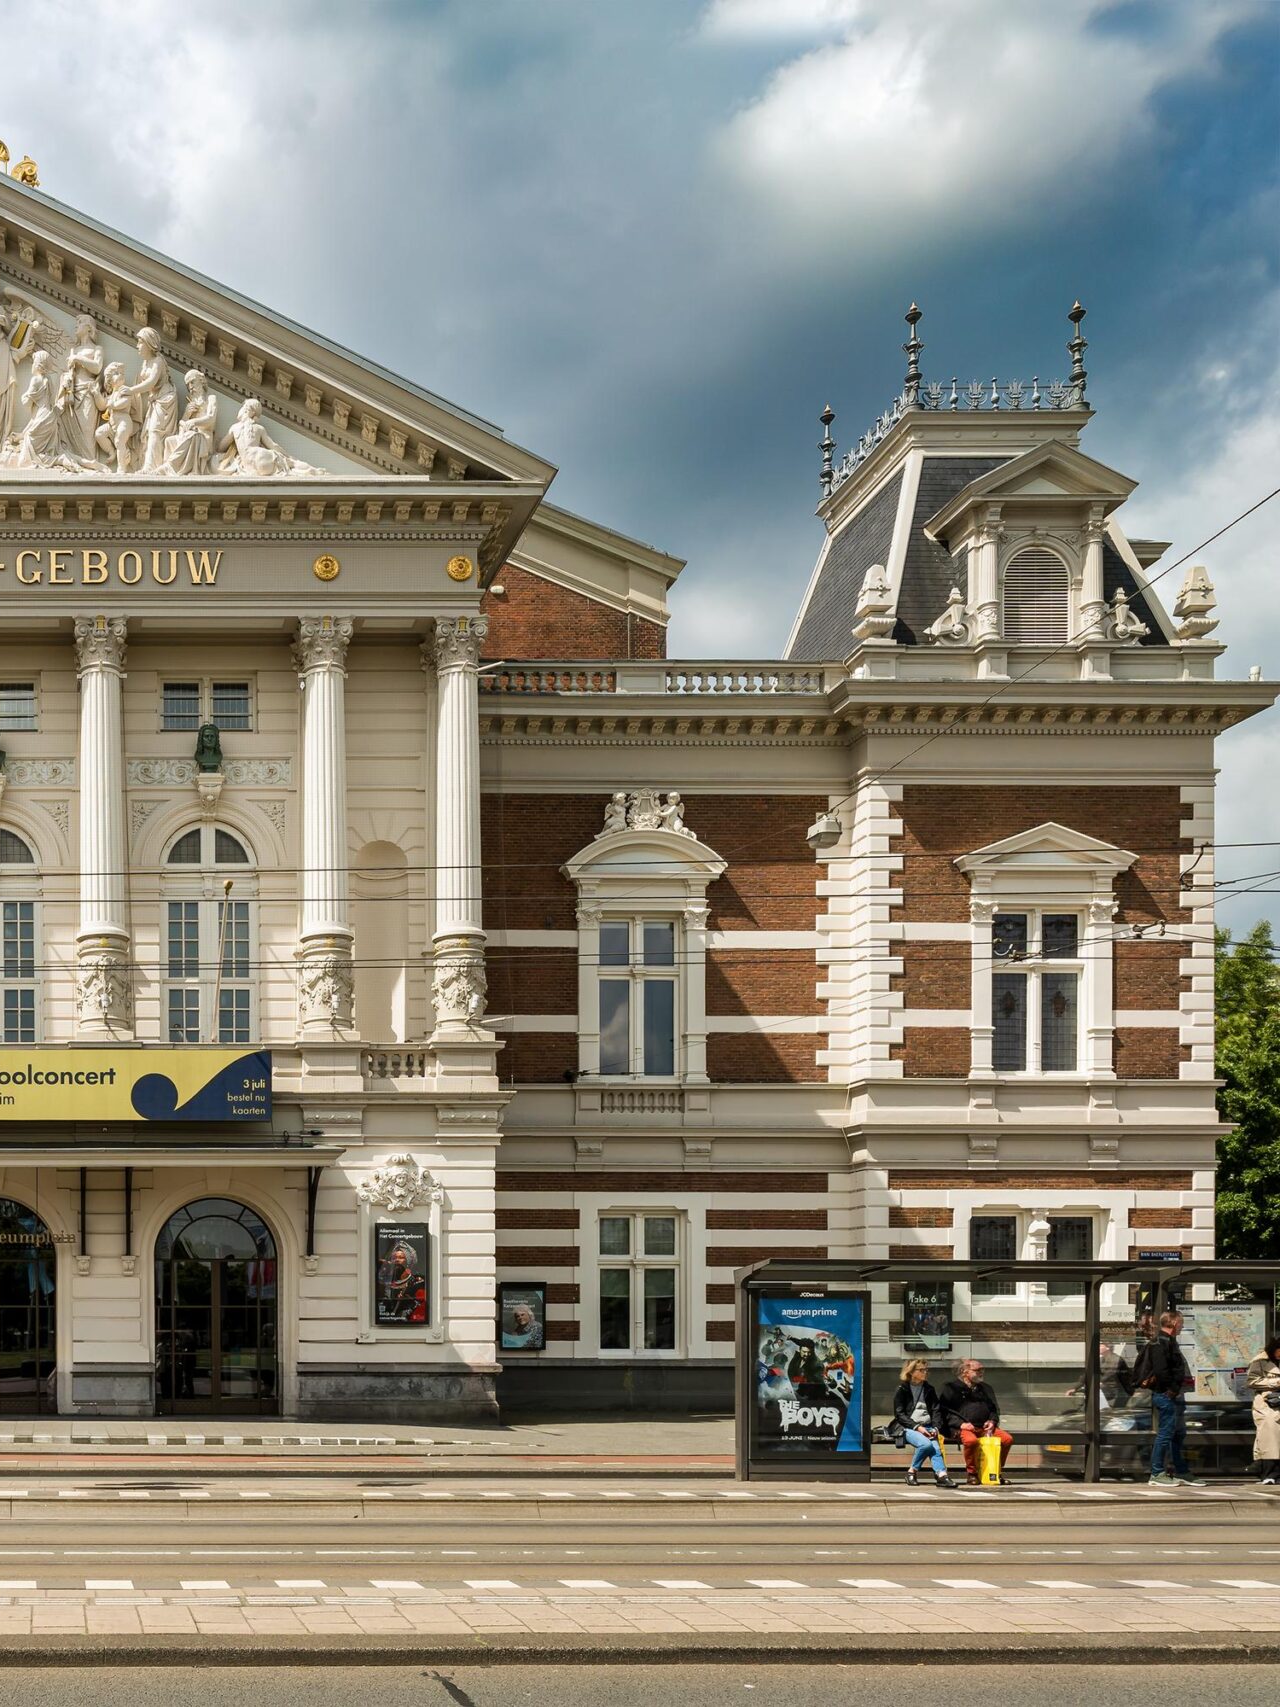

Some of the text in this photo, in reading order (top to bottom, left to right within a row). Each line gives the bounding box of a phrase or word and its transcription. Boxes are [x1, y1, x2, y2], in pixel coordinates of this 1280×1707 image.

[243, 1079, 266, 1091] 3 juli
[227, 1092, 266, 1102] bestel nu
[232, 1105, 266, 1115] kaarten
[930, 1295, 937, 1303] 6
[781, 1307, 838, 1317] amazon prime
[778, 1399, 800, 1409] THE
[780, 1406, 840, 1431] BOYS
